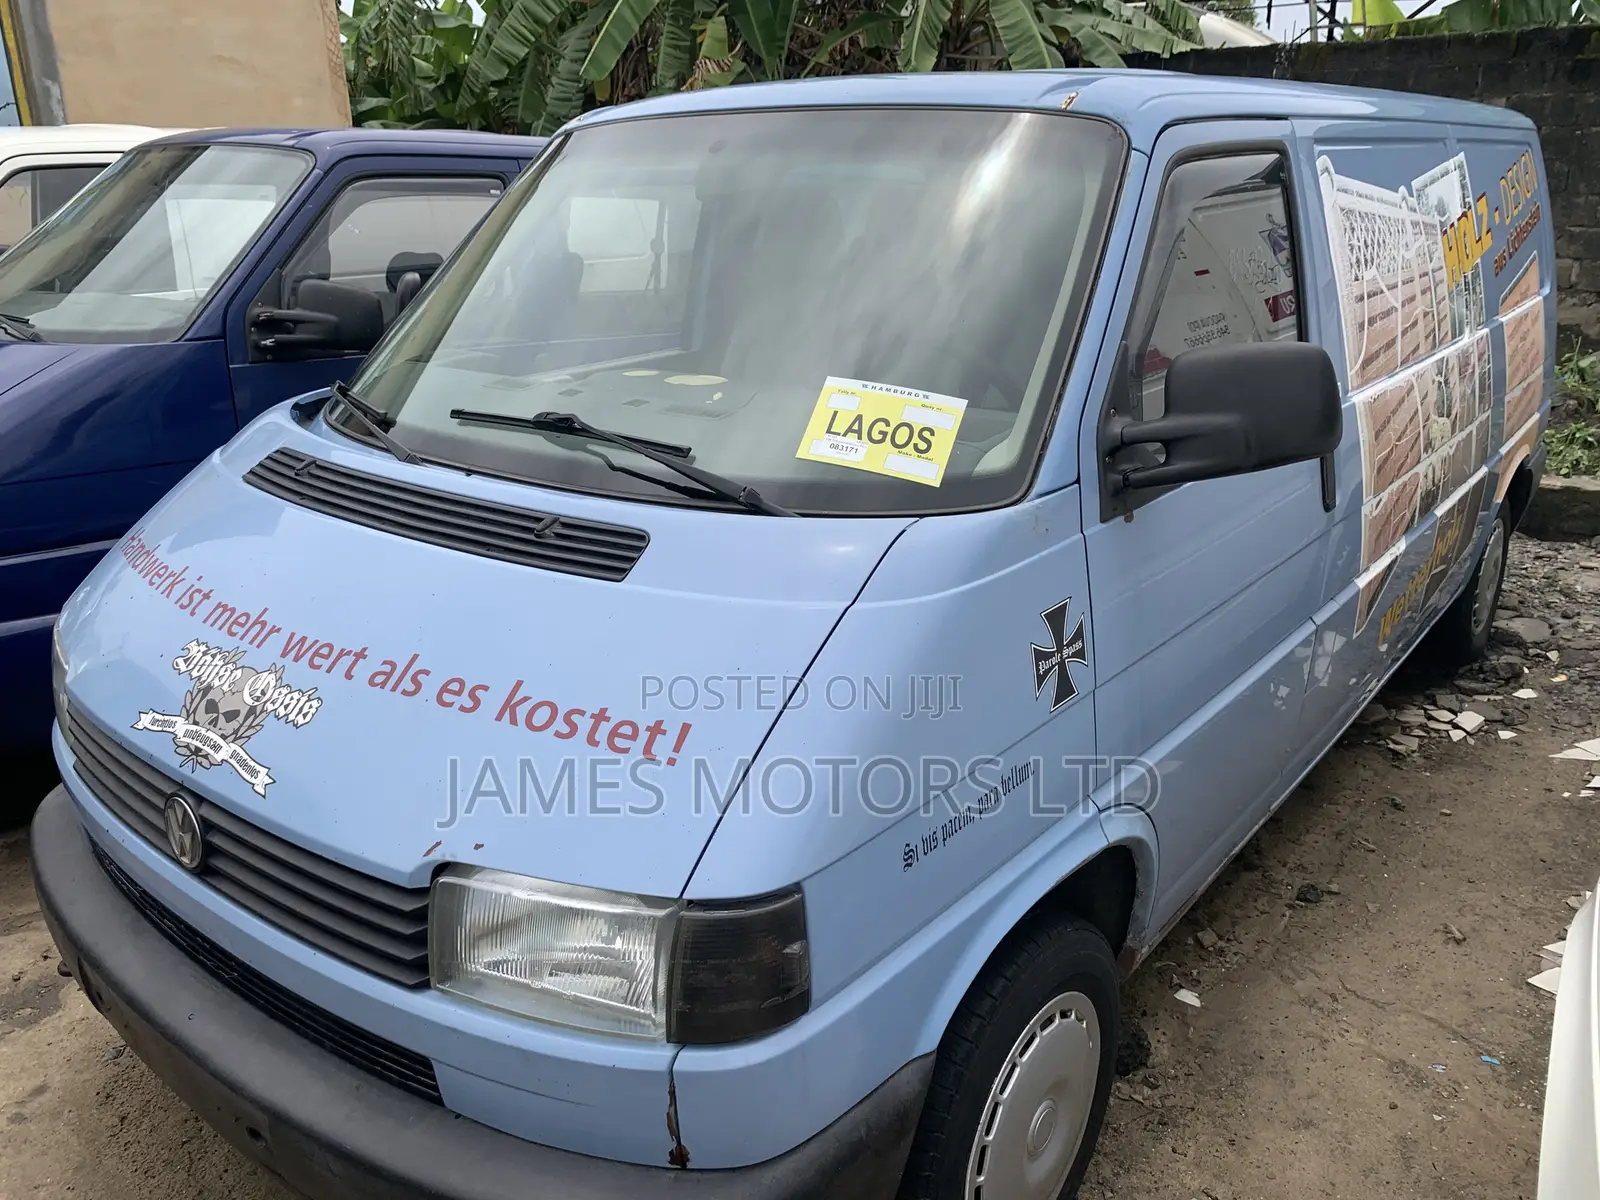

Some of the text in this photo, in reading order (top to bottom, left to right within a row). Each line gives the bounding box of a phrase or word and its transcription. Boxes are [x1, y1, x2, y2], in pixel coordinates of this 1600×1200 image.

[1442, 192, 1492, 291] HOLZ
[1500, 150, 1538, 225] DESIGN
[1494, 248, 1507, 277] aus
[871, 385, 920, 398] HAMBURG
[826, 410, 935, 454] LAGOS
[829, 442, 859, 454] 083171
[121, 527, 692, 767] Handwerk ist mehr wert als es kostet!
[1039, 639, 1082, 675] Parole Spass
[921, 826, 939, 856] vis
[977, 786, 999, 820] para
